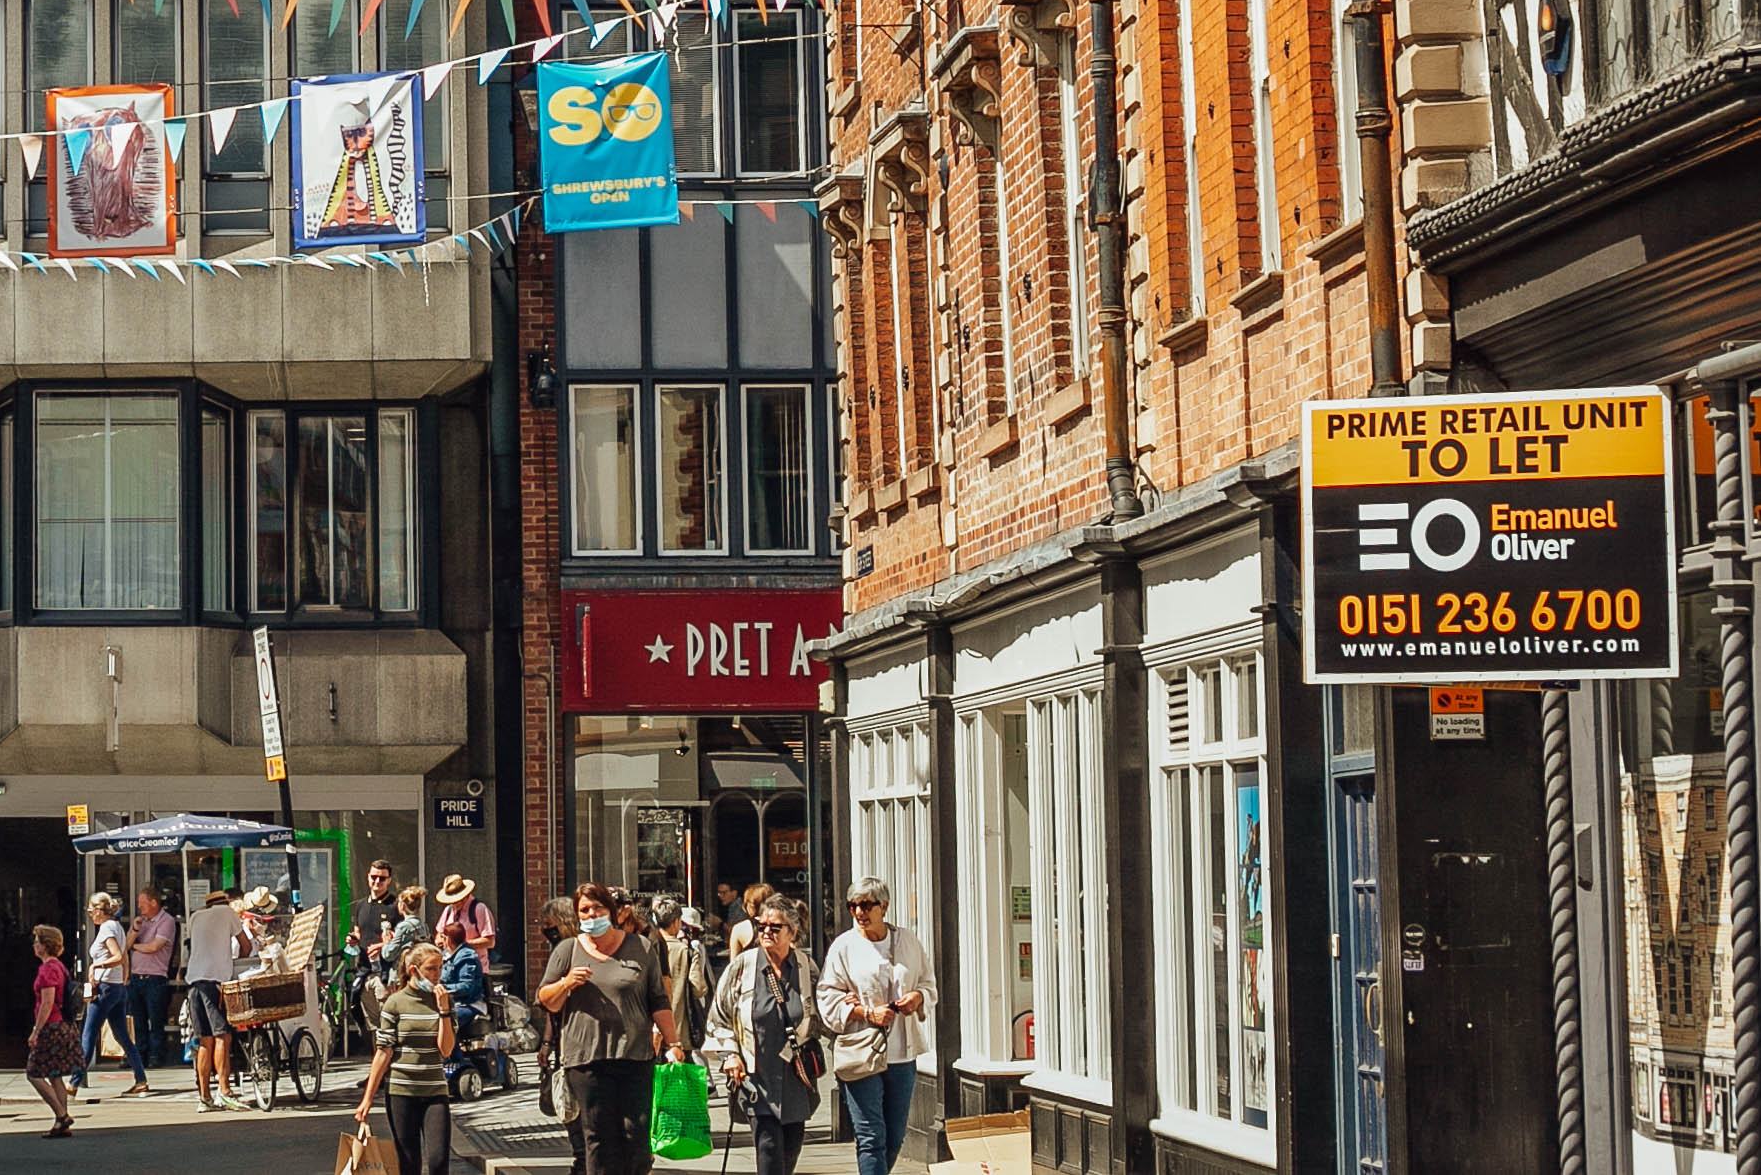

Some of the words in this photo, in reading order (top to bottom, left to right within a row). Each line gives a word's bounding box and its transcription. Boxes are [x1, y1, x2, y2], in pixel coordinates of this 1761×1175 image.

[548, 82, 662, 146] SO
[552, 176, 666, 195] SHREWSBURY'S
[590, 191, 630, 204] OPEN
[1328, 411, 1426, 439] PRIME
[1441, 406, 1549, 434] RETAIL
[1563, 401, 1647, 429] UNIT
[1402, 439, 1467, 477] TO
[1489, 434, 1569, 475] LET
[1491, 500, 1617, 531] Emanuel
[1358, 498, 1481, 572] EO
[1491, 534, 1575, 561] Oliver
[1339, 594, 1421, 636] 0151
[1436, 591, 1516, 633] 236
[1531, 589, 1641, 631] 6700
[686, 623, 773, 676] PRET
[789, 623, 811, 676] A
[1341, 637, 1640, 657] www.emanueloliver.com
[1436, 717, 1448, 725] No
[1450, 717, 1480, 726] loading
[1436, 727, 1444, 735] at
[440, 800, 477, 812] PRIDE
[446, 815, 472, 827] HILL
